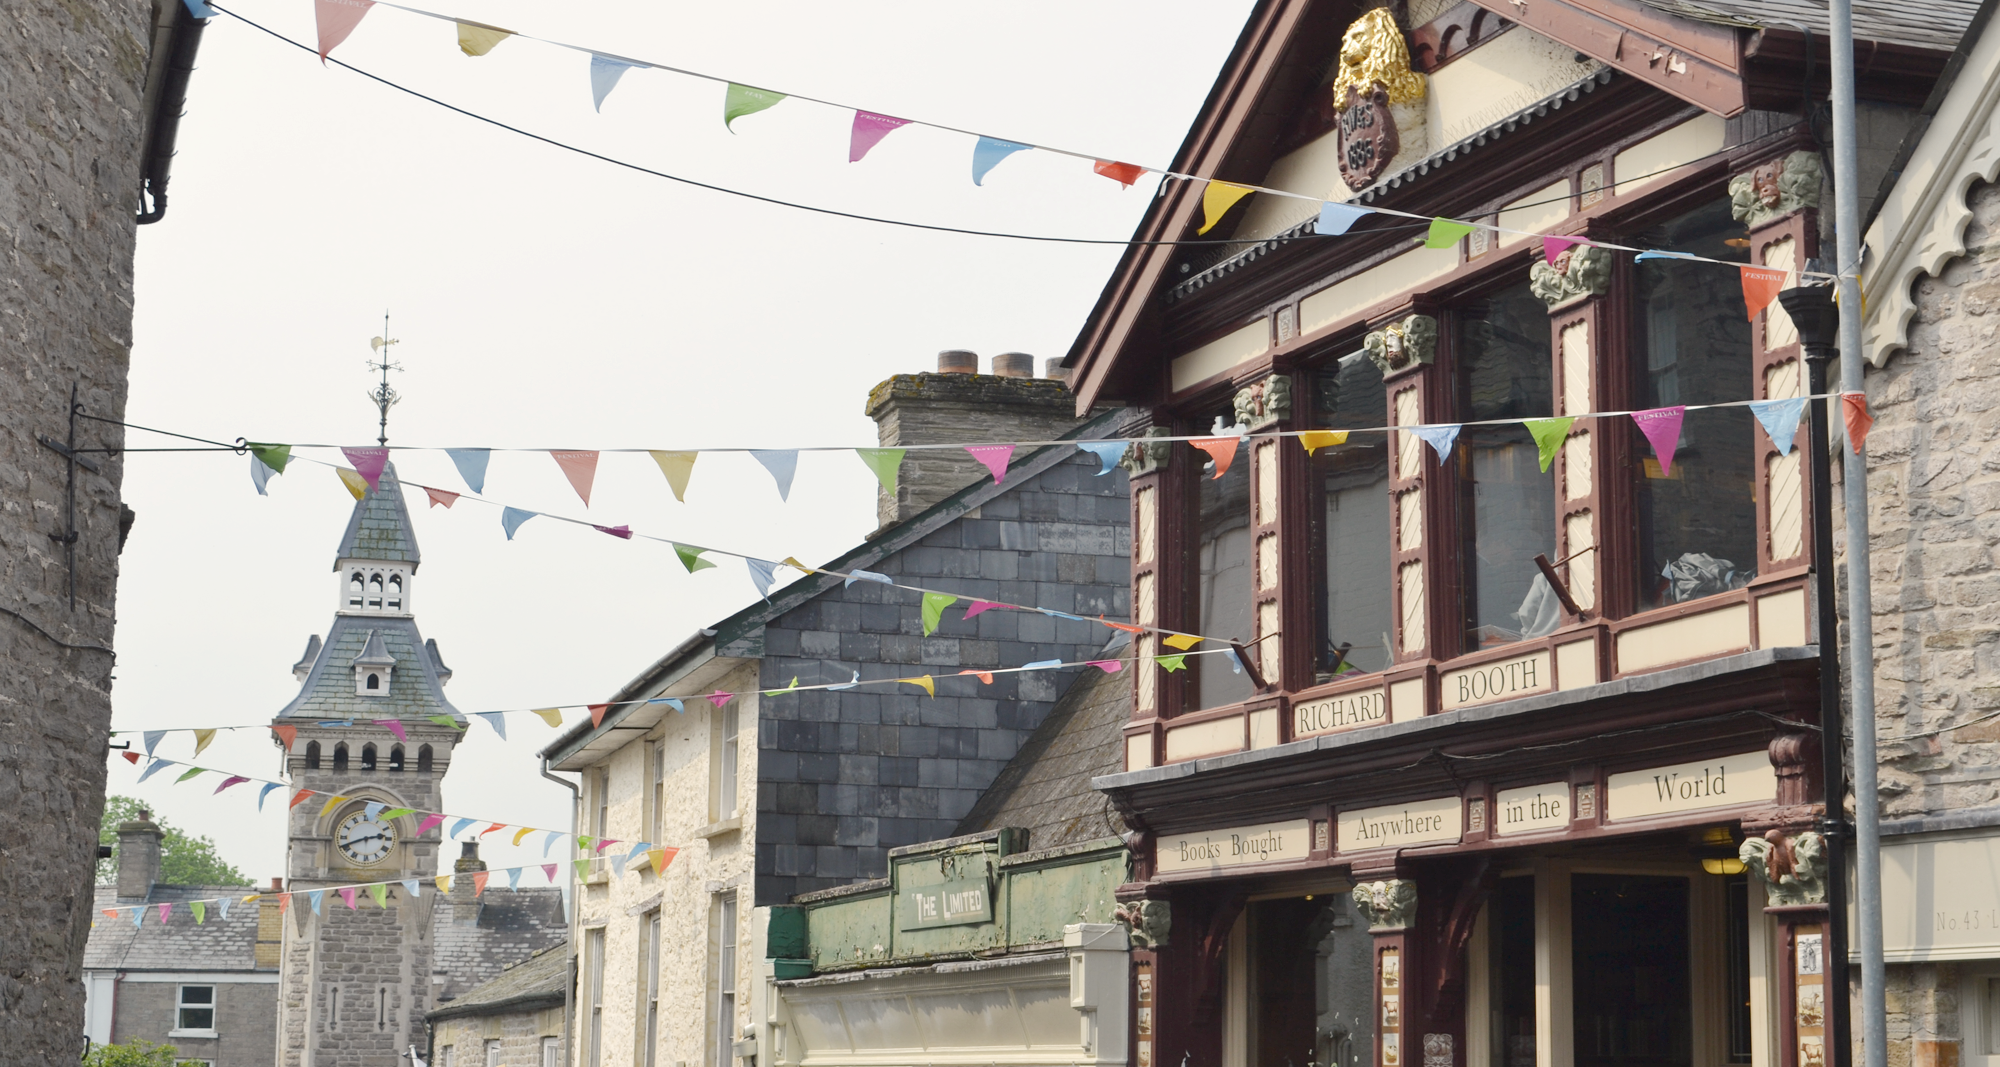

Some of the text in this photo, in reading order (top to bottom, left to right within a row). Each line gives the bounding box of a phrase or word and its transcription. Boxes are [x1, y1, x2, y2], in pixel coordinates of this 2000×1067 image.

[323, 0, 367, 9] ESTIVAL
[744, 90, 765, 100] HAY
[859, 113, 904, 126] FESTIVAL
[1744, 271, 1784, 283] FESTIVAL
[1766, 403, 1787, 412] HAY
[1637, 409, 1681, 422] FESTIVAL
[556, 452, 597, 460] FESTIVAL
[1299, 658, 1538, 733] RICHARD BOOTH
[1180, 765, 1726, 862] Books Bought Anywhere in the World
